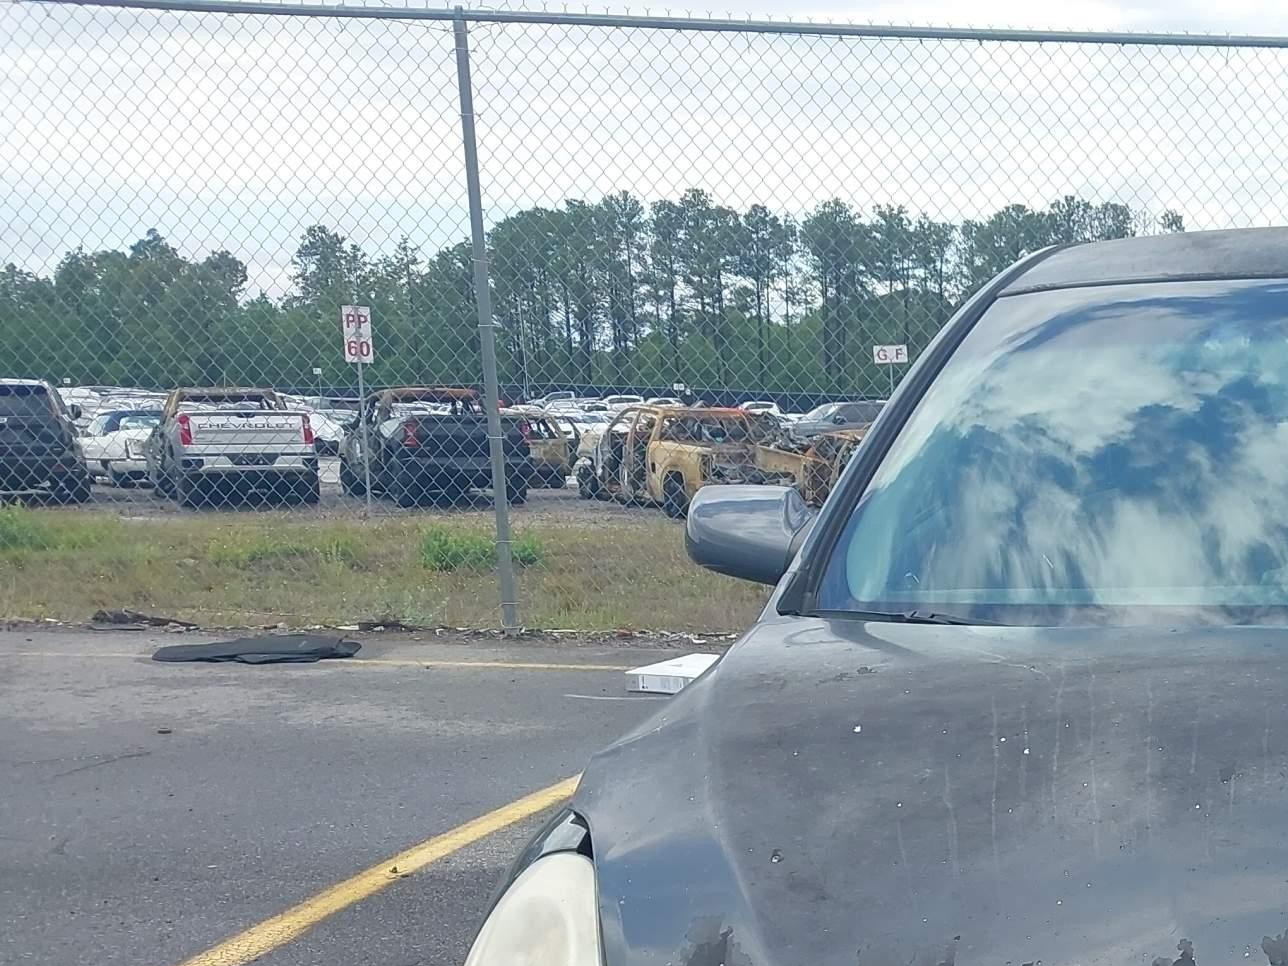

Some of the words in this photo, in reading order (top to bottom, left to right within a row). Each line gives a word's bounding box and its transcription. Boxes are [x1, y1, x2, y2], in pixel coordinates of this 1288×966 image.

[346, 313, 368, 329] PP
[347, 340, 371, 357] 60
[197, 422, 296, 430] CHEVROLET
